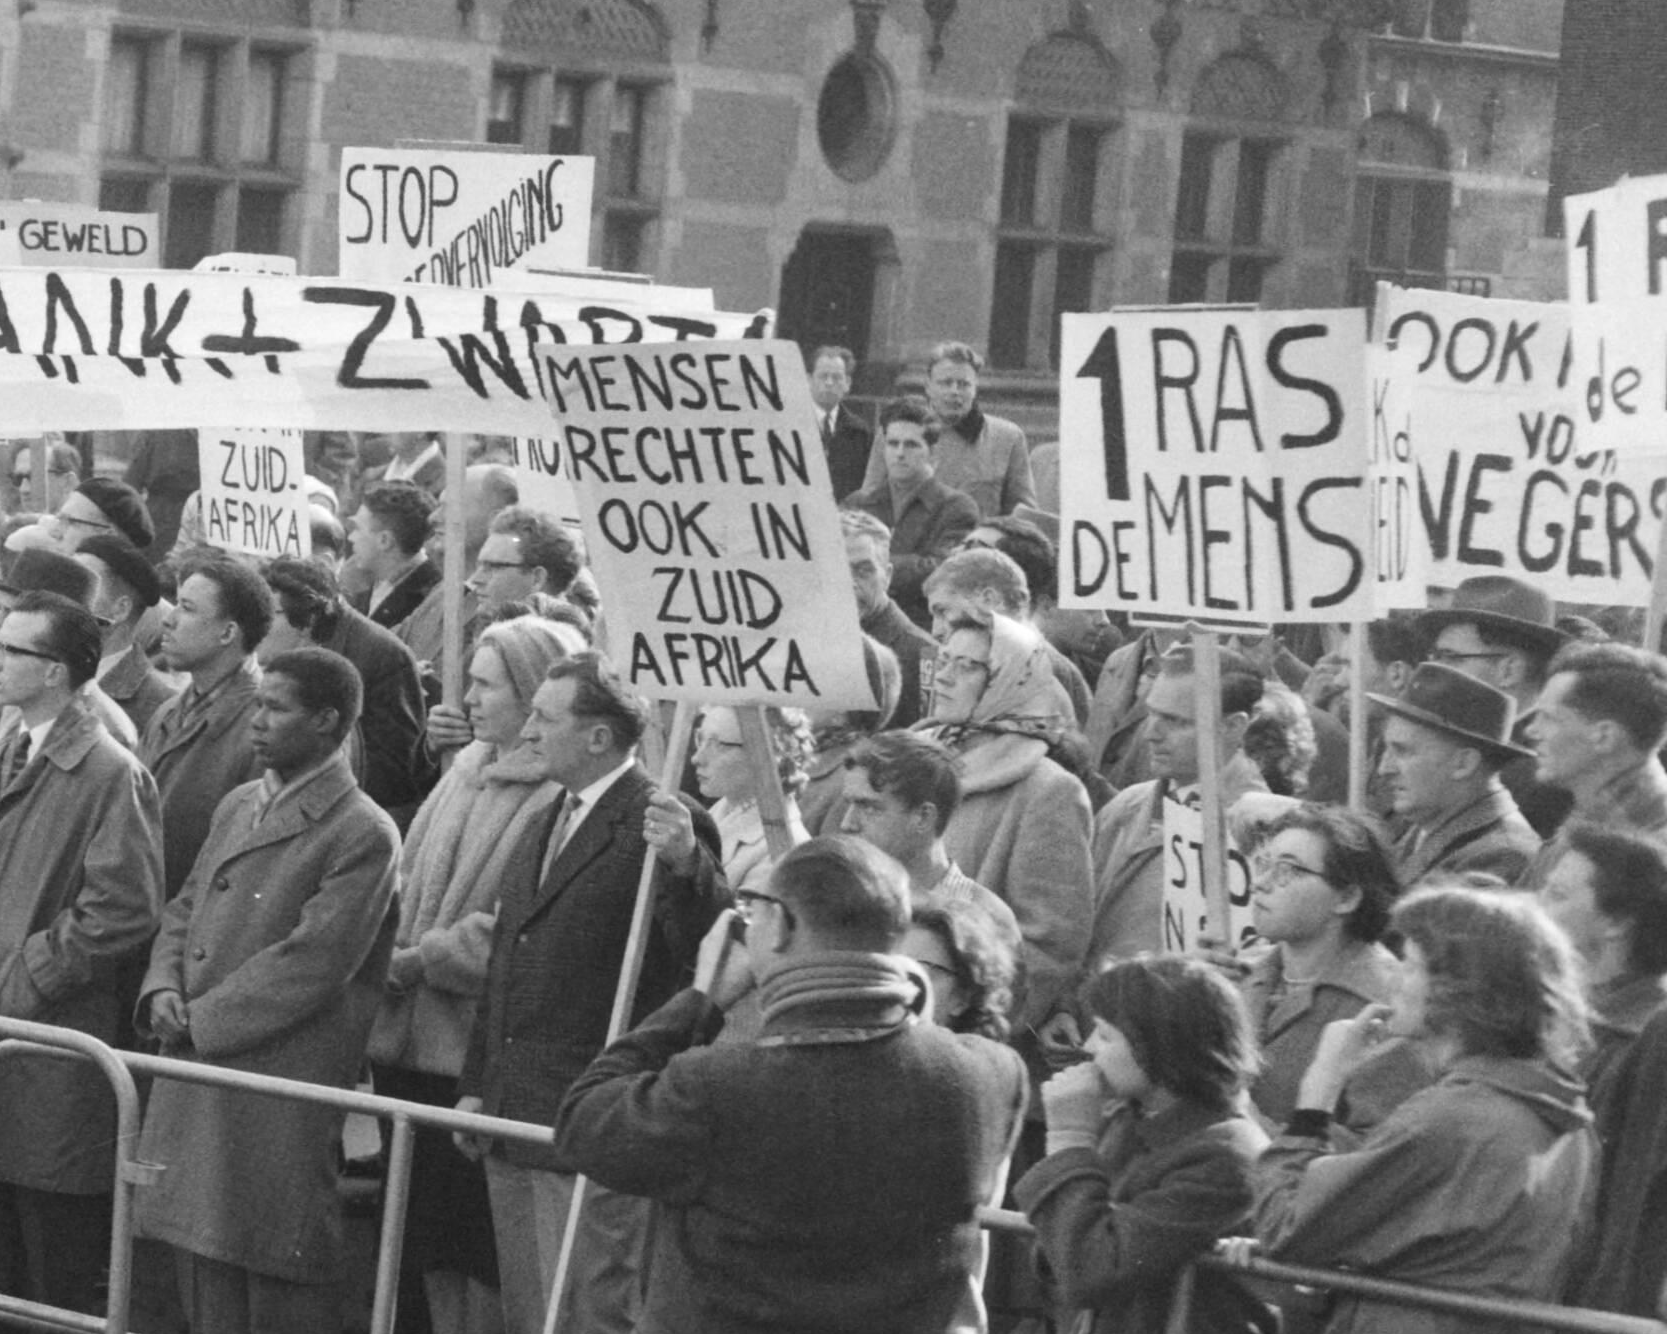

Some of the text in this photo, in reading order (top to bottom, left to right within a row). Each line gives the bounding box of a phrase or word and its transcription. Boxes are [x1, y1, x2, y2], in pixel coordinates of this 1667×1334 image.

[18, 219, 147, 256] GEWELD
[346, 163, 458, 249] STOP
[1386, 310, 1540, 383] OOK
[546, 352, 783, 414] MENSEN
[1075, 323, 1345, 501] 1 RAS
[1586, 336, 1642, 423] de
[564, 425, 811, 486] RECHTEN
[209, 497, 301, 559] AFRIKA
[598, 498, 812, 562] OOK IN
[1072, 472, 1365, 612] DE MENS
[652, 567, 783, 630] ZUID
[630, 631, 821, 697] AFRIKA
